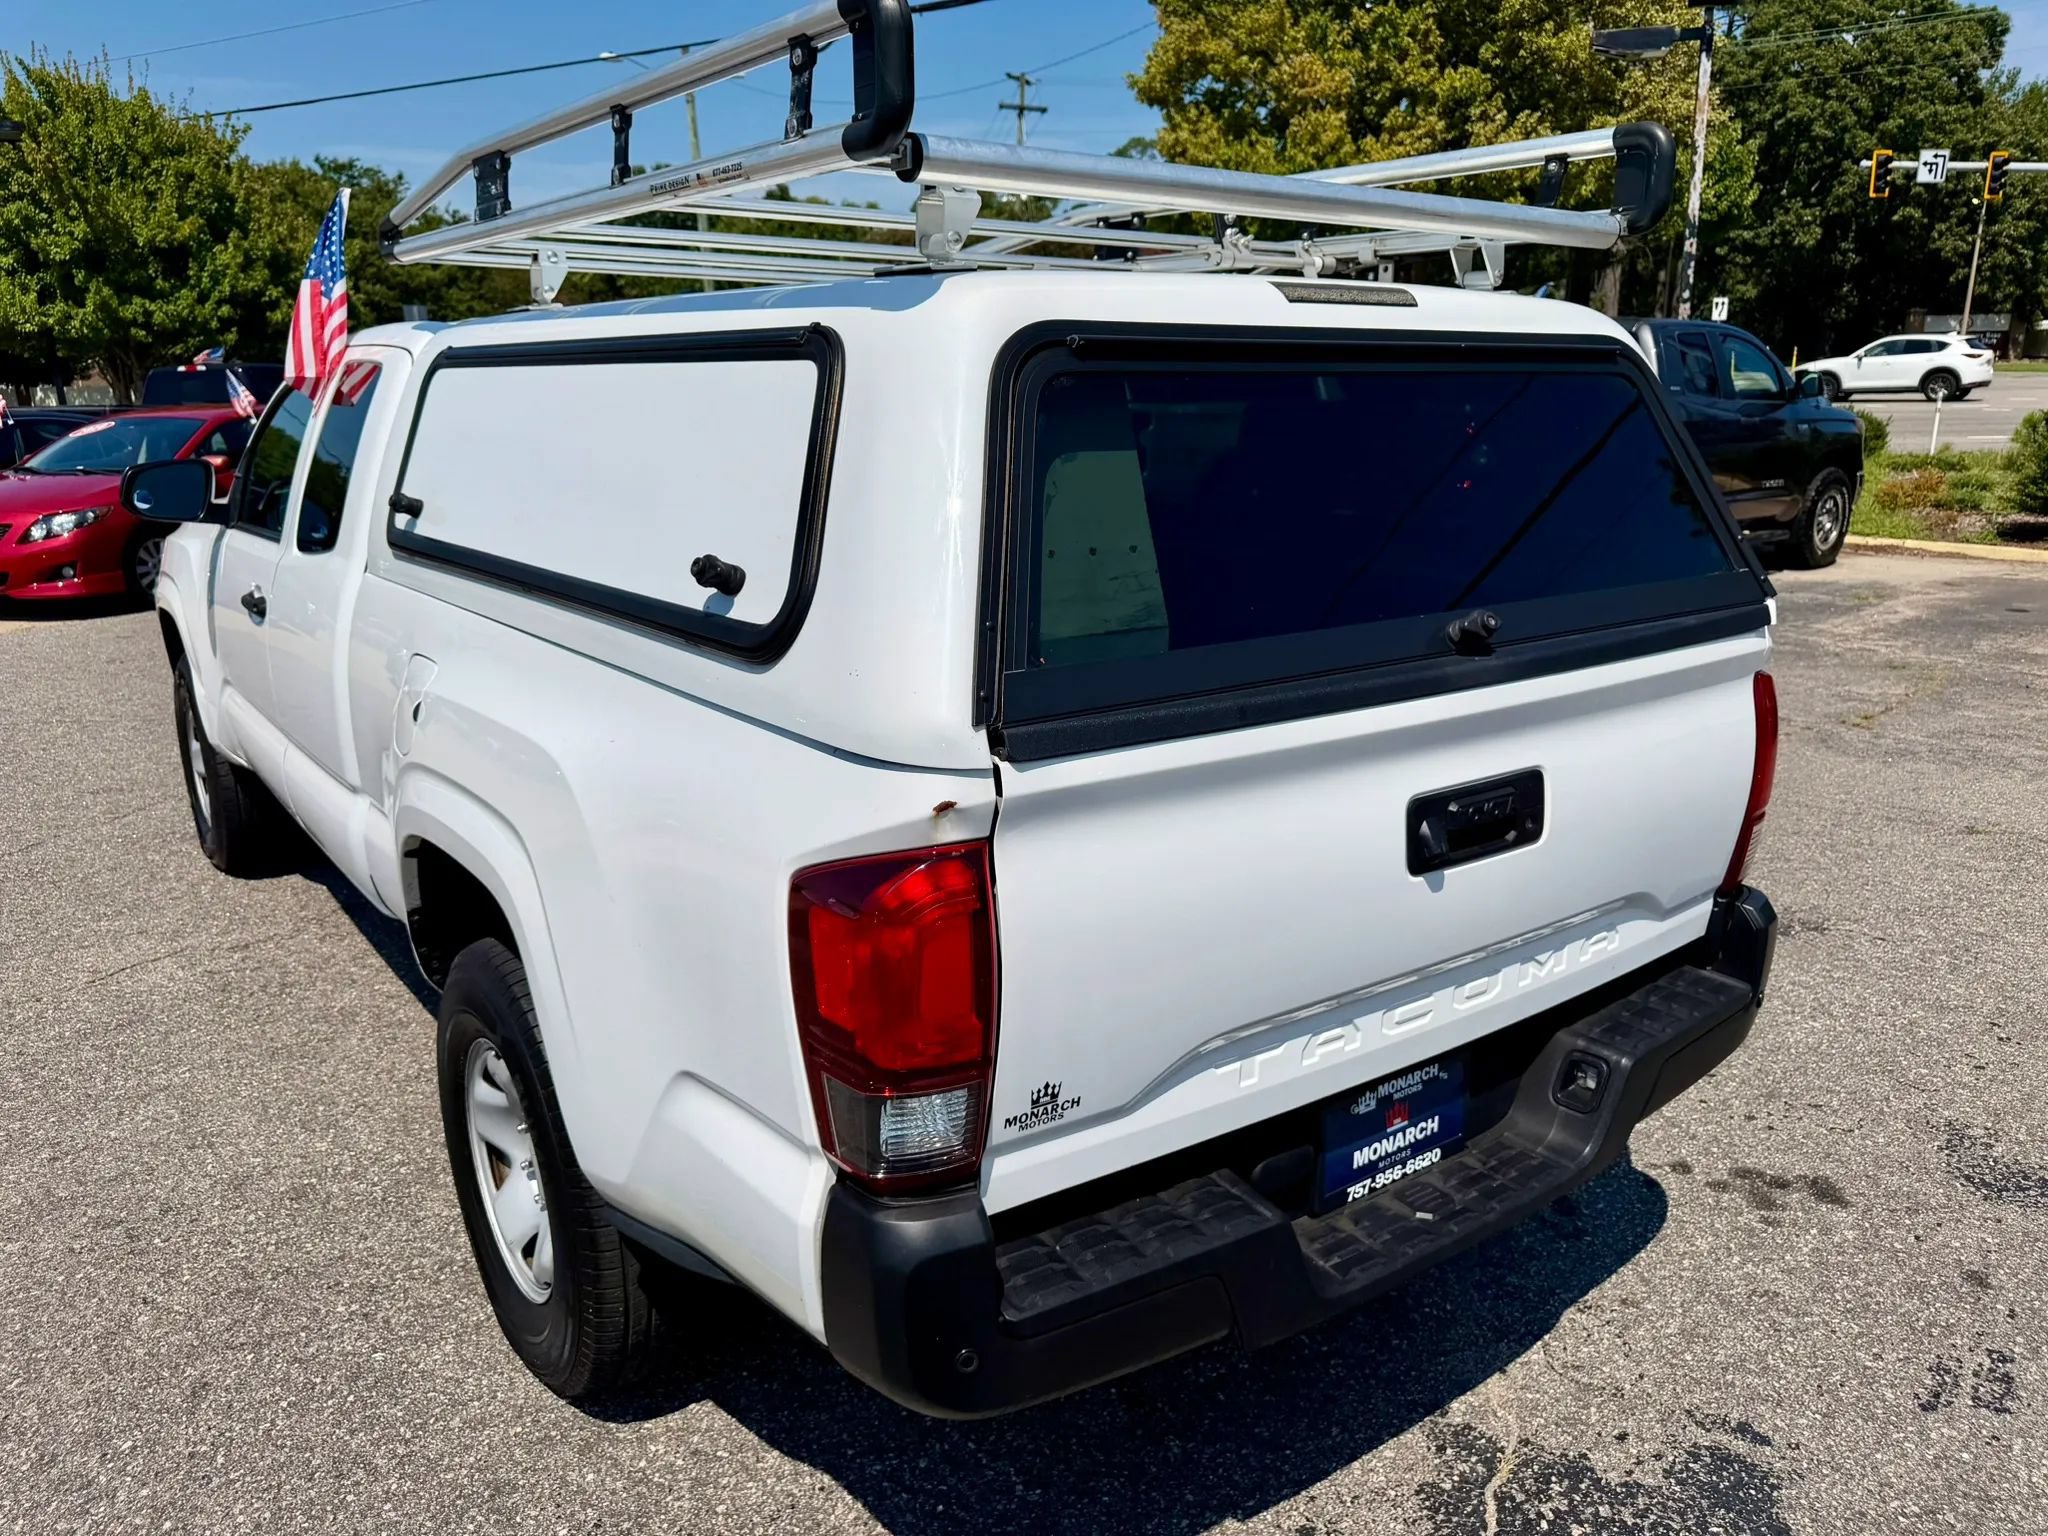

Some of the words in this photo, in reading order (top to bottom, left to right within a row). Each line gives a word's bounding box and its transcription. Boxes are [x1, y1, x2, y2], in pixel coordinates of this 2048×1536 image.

[668, 175, 690, 188] DESIGN
[1214, 927, 1620, 1087] TACOMA
[1377, 1064, 1439, 1098] MONARCH
[1393, 1083, 1423, 1100] MOTORS
[1004, 1096, 1081, 1129] MONARCH
[1018, 1112, 1064, 1132] MOTORS
[1353, 1115, 1439, 1169] MONARCH
[1378, 1149, 1411, 1168] MOTORS
[1347, 1148, 1441, 1202] 757-956-6620
